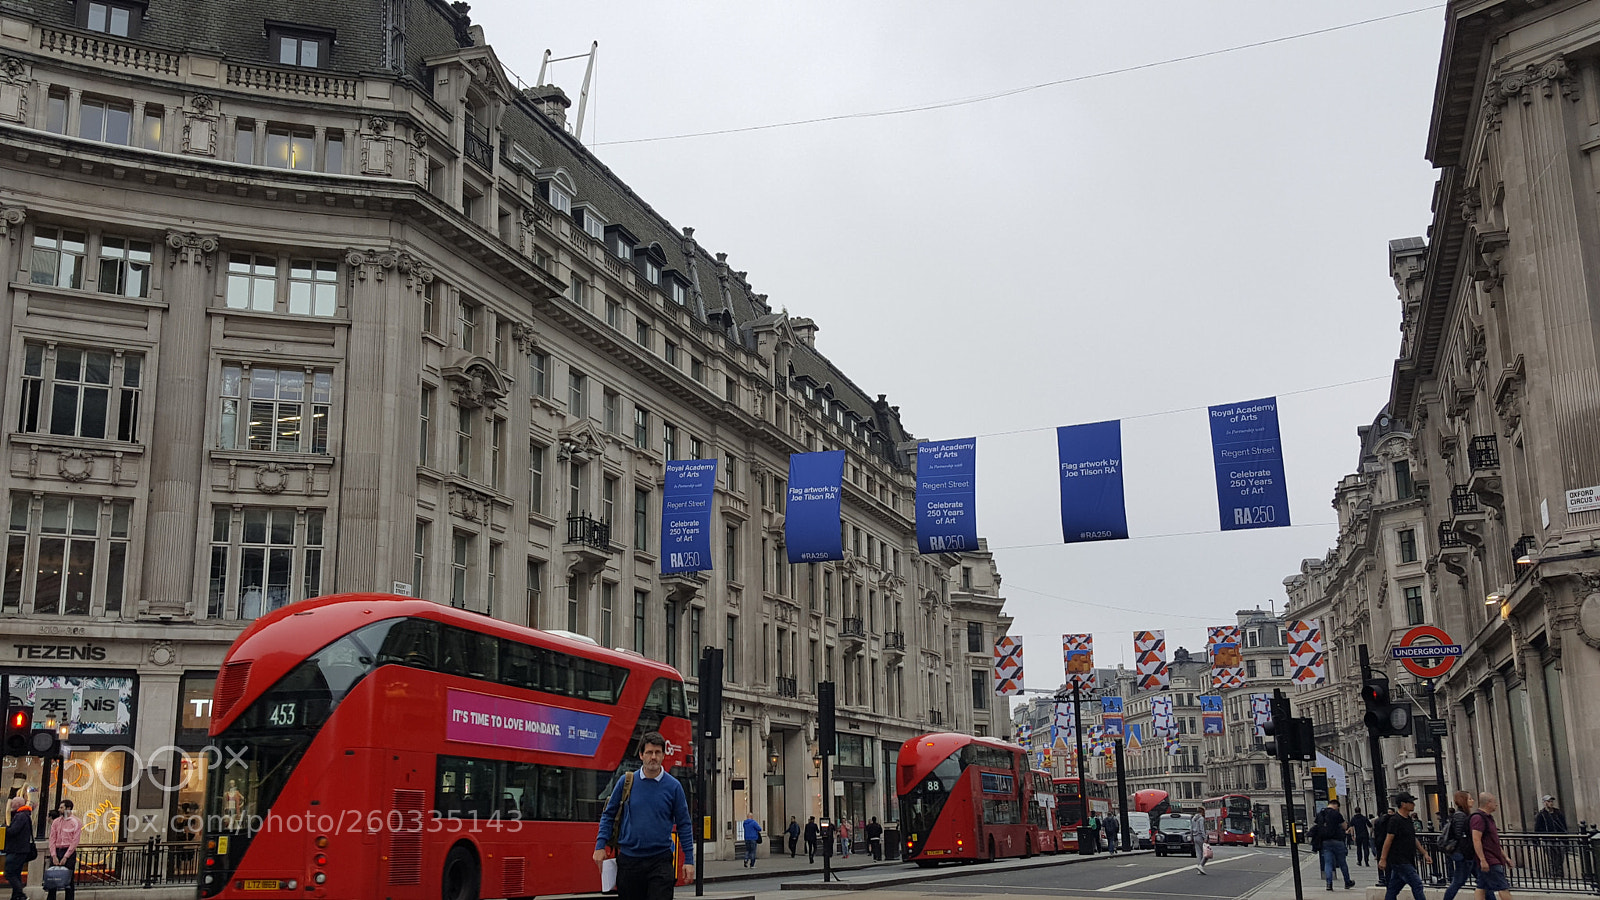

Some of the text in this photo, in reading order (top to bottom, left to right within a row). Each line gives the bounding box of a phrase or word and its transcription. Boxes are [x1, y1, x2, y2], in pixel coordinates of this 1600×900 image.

[1211, 404, 1275, 418] Royal Academy
[940, 443, 974, 451] Academy
[1221, 446, 1275, 458] Regent Street
[1079, 459, 1108, 468] artwork
[1230, 469, 1271, 479] Celebrate
[923, 480, 969, 490] Regent Street
[1230, 478, 1272, 488] 250 Years
[831, 485, 838, 493] by
[1241, 486, 1264, 495] of Art
[1570, 490, 1594, 498] OXFORD
[667, 501, 688, 510] Regent
[928, 501, 963, 509] Celebrate
[1570, 497, 1593, 505] CIRCUS
[1234, 505, 1275, 524] RA250
[670, 520, 699, 528] Celebrate
[929, 535, 965, 551] RA250
[670, 552, 700, 568] RA250
[1395, 647, 1459, 656] UNDERGROUND
[270, 703, 296, 725] 453
[452, 709, 469, 723] IT'S
[470, 712, 489, 726] TIME
[491, 715, 502, 727] TO
[504, 717, 523, 731] LOVE
[525, 720, 561, 736] MONDAYS.
[927, 781, 939, 791] 88
